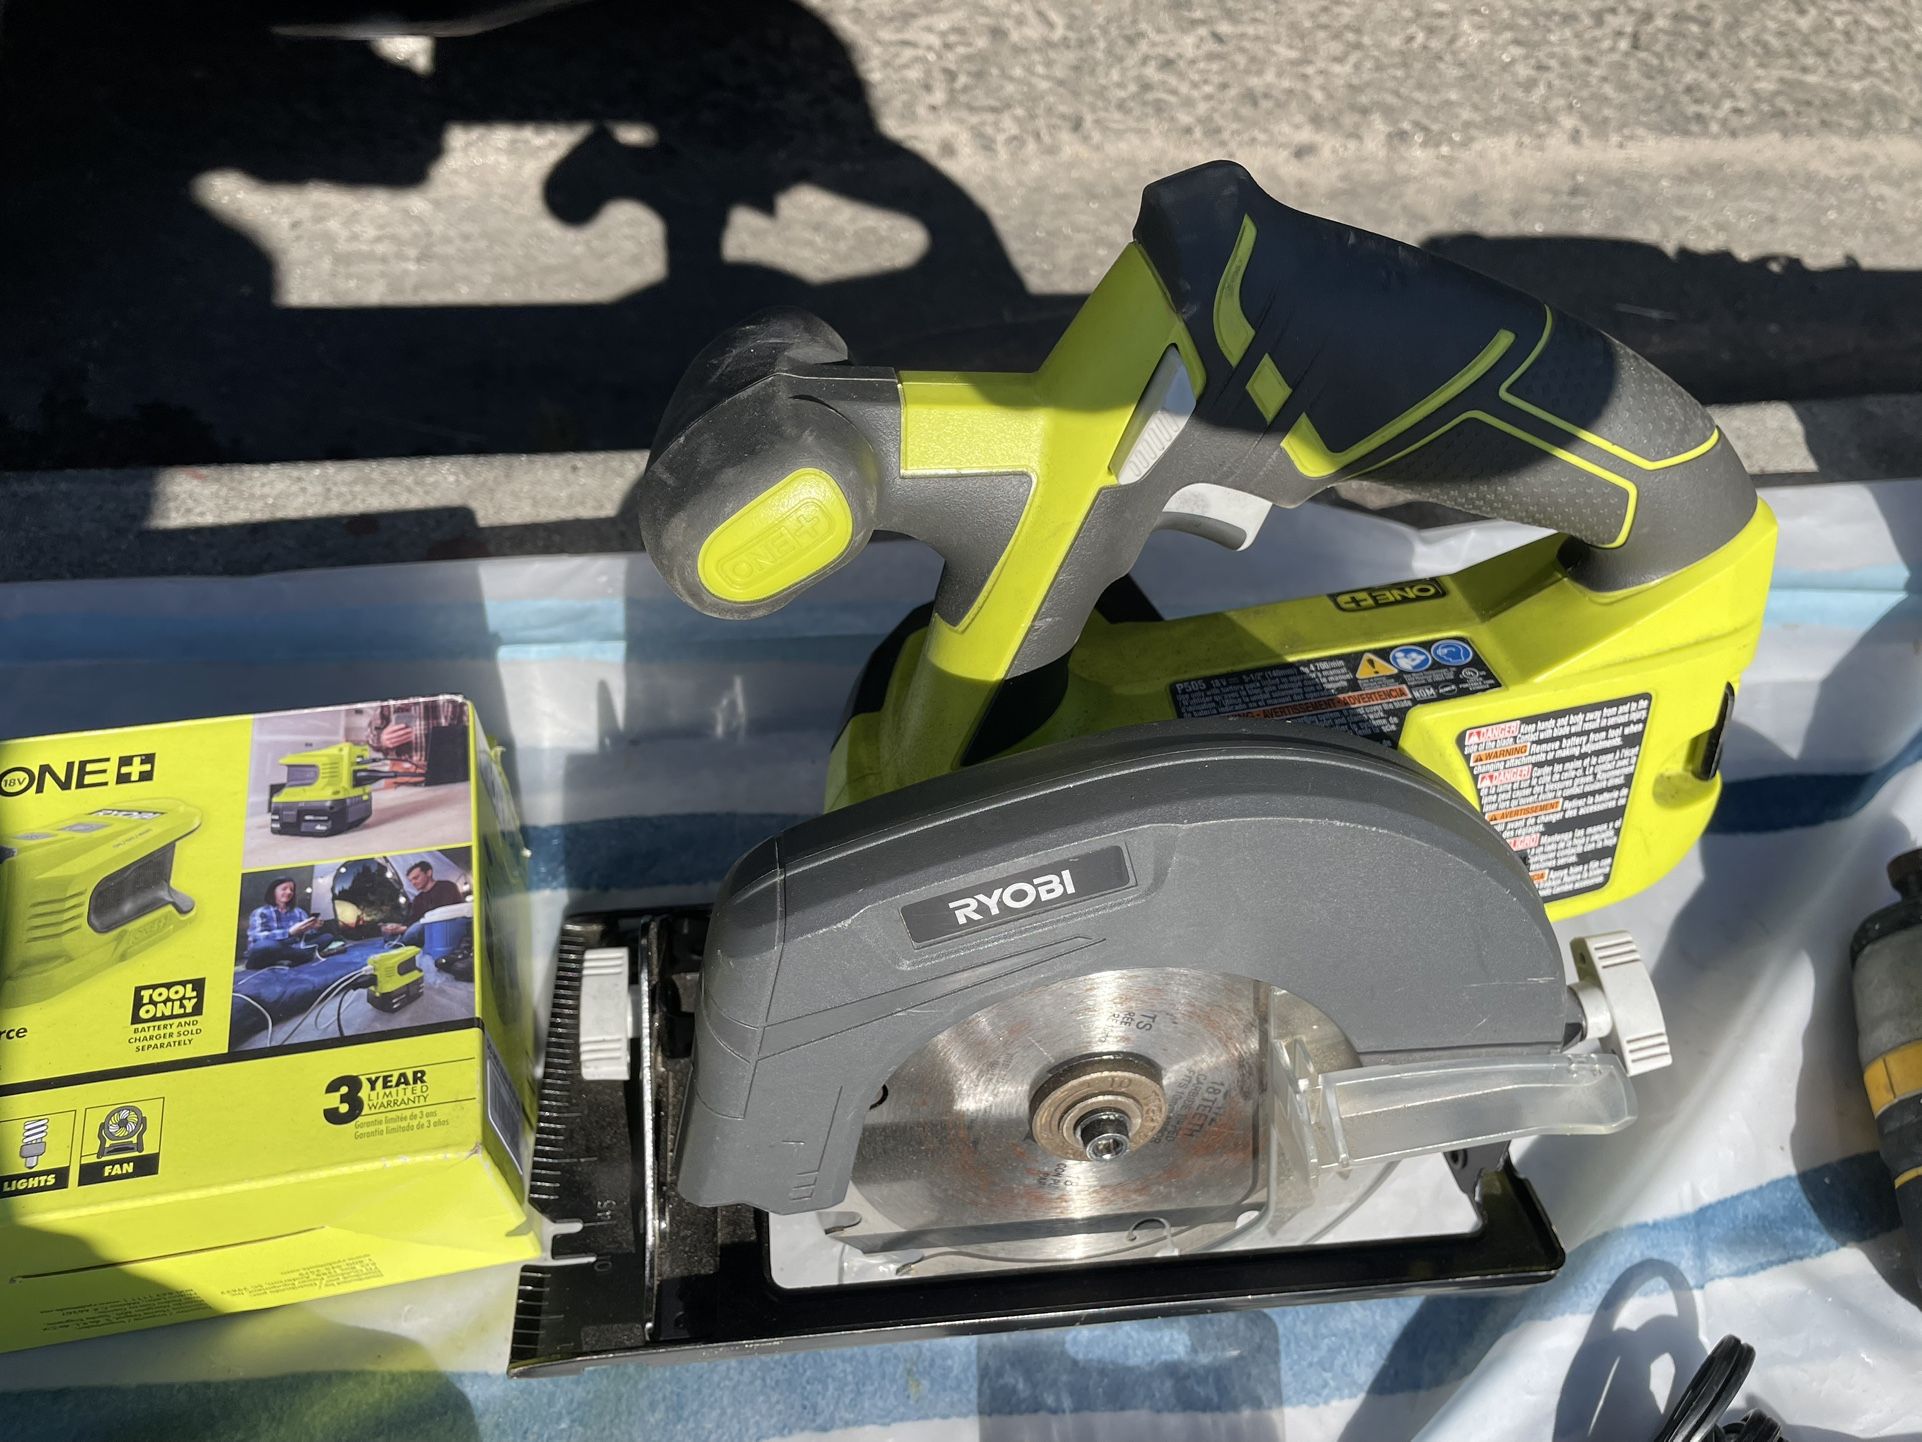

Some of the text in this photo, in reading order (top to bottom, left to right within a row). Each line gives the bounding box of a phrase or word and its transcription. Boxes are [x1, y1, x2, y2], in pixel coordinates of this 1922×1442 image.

[1175, 679, 1206, 693] P505
[1342, 685, 1406, 708] ADVERTENCIA
[1479, 723, 1517, 740] DANGER!
[1520, 721, 1536, 734] Keep
[1537, 717, 1555, 729] hands
[1556, 714, 1568, 726] and
[1568, 711, 1584, 728] body
[1584, 709, 1601, 725] away
[1601, 704, 1617, 717] from
[1484, 740, 1495, 750] the
[1516, 731, 1538, 744] Contact
[1539, 728, 1552, 739] with
[1553, 725, 1569, 737] blade
[1484, 721, 1643, 761] WARNING Remove battery from tool when
[1472, 760, 1504, 774] changing
[1504, 751, 1546, 768] attachments
[1547, 750, 1554, 760] or
[1555, 744, 1580, 759] making
[3, 777, 27, 788] 18V
[1493, 766, 1530, 782] DANGER!
[1499, 800, 1558, 820] AVERTISSEMENT
[1536, 810, 1563, 826] changer
[1564, 808, 1577, 818] des
[948, 869, 1076, 925] RYOBI
[140, 983, 197, 1004] TOOL
[138, 998, 198, 1020] ONLY
[0, 1027, 28, 1040] rce
[128, 1028, 202, 1044] CHARGER SOLD
[133, 1019, 199, 1034] BATTERY AND
[135, 1038, 194, 1053] SEPARATELY
[366, 1069, 427, 1092] YEAR
[323, 1074, 364, 1126] 3
[367, 1084, 429, 1102] LIMITED
[367, 1093, 430, 1111] WARRANTY
[1183, 1081, 1225, 1137] 18 TEETH
[354, 1110, 437, 1130] Garantie limitée de 3 ans
[385, 1123, 415, 1135] limitada
[416, 1120, 425, 1130] de
[426, 1119, 432, 1128] 3
[104, 1162, 134, 1177] FAN
[3, 1174, 56, 1192] LIGHTS
